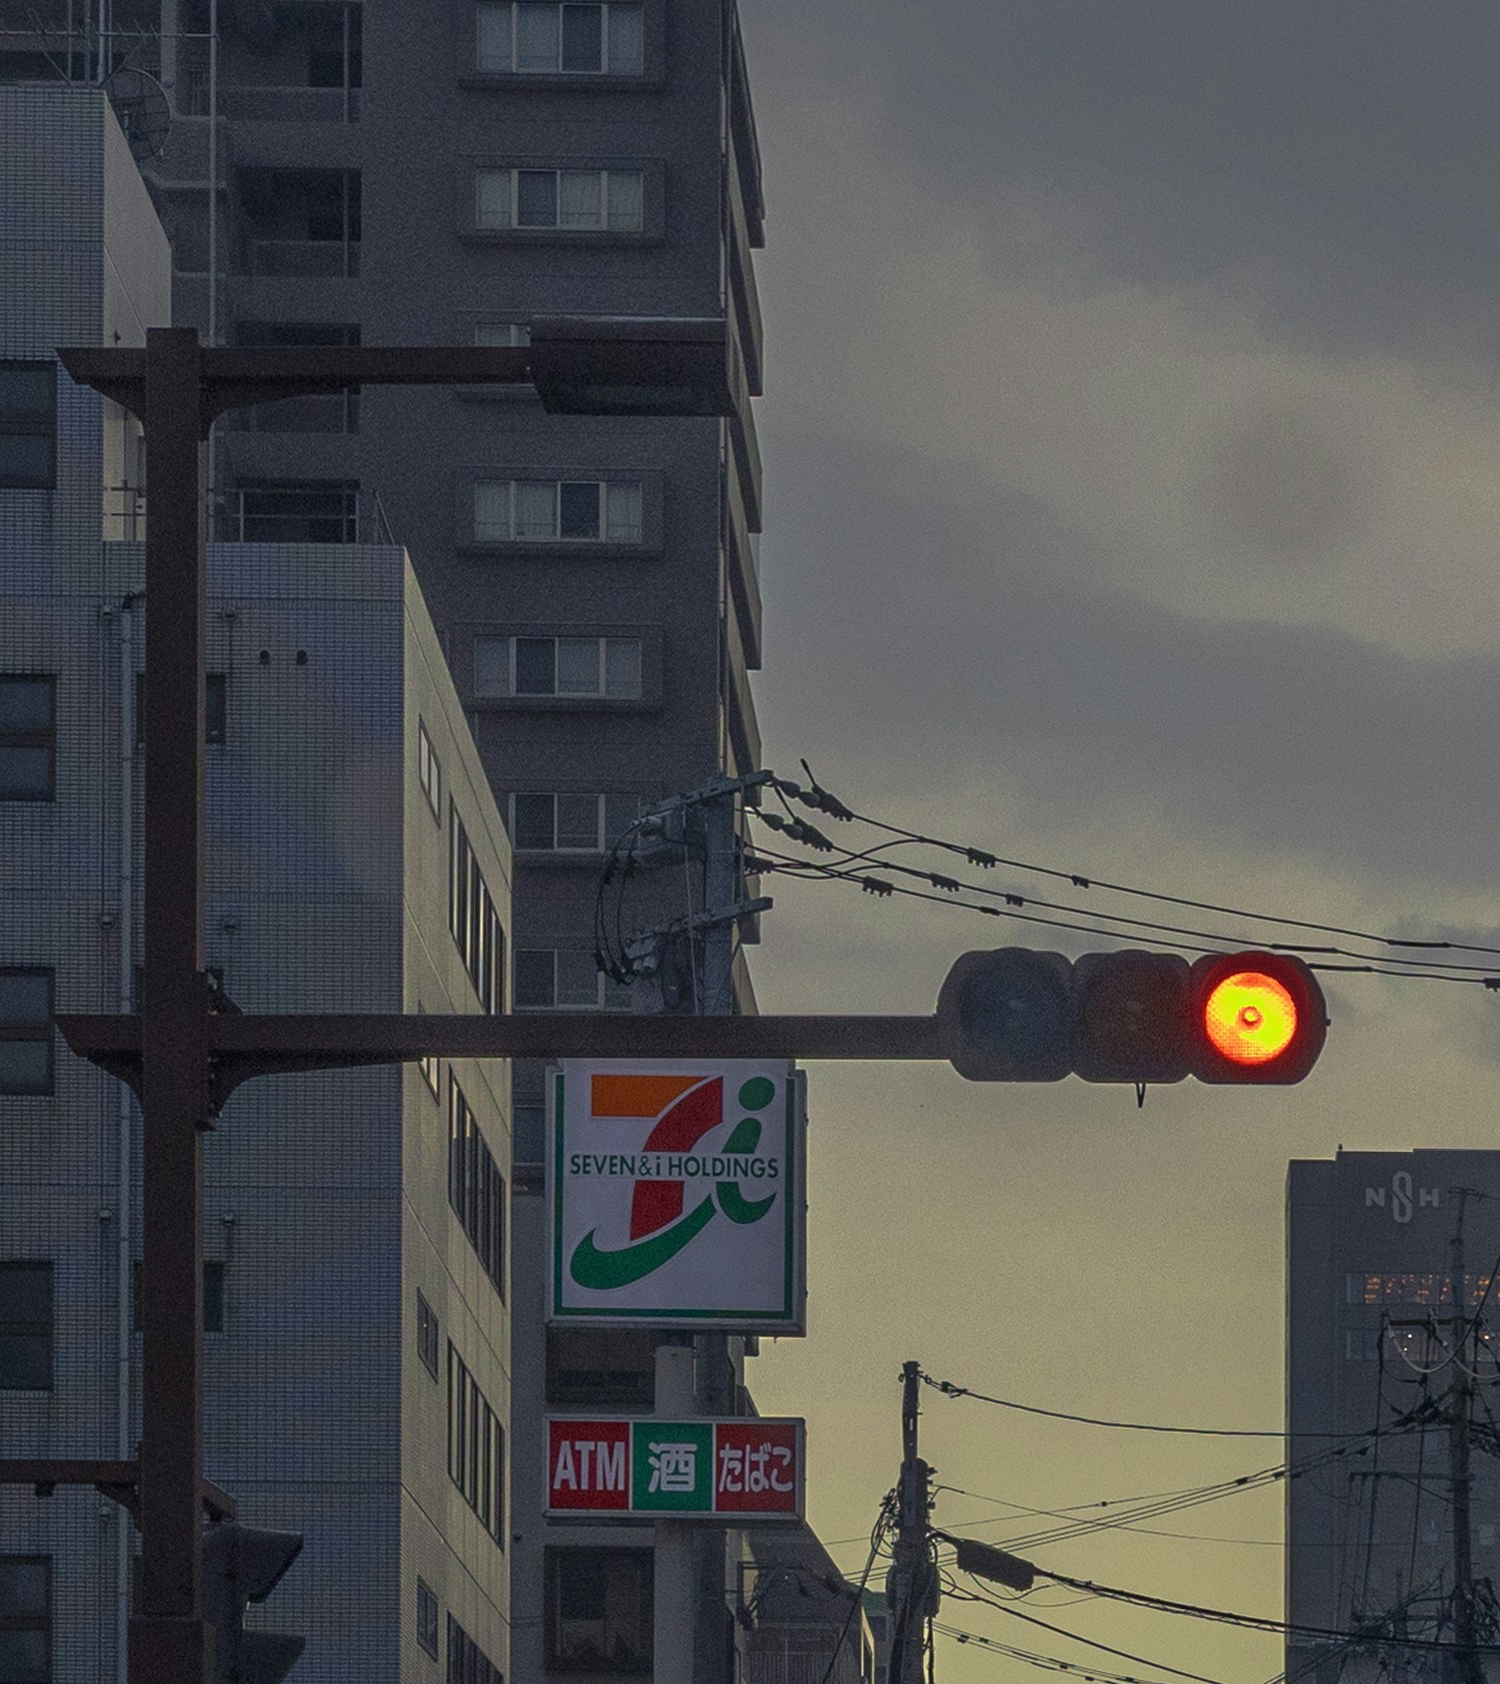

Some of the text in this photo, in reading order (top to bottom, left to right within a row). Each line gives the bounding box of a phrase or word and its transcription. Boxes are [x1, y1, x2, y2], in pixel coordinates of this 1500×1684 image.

[668, 1156, 778, 1179] HOLDINGS
[553, 1441, 625, 1491] ATM
[648, 1443, 697, 1492] 酒
[719, 1444, 793, 1492] たばこ
